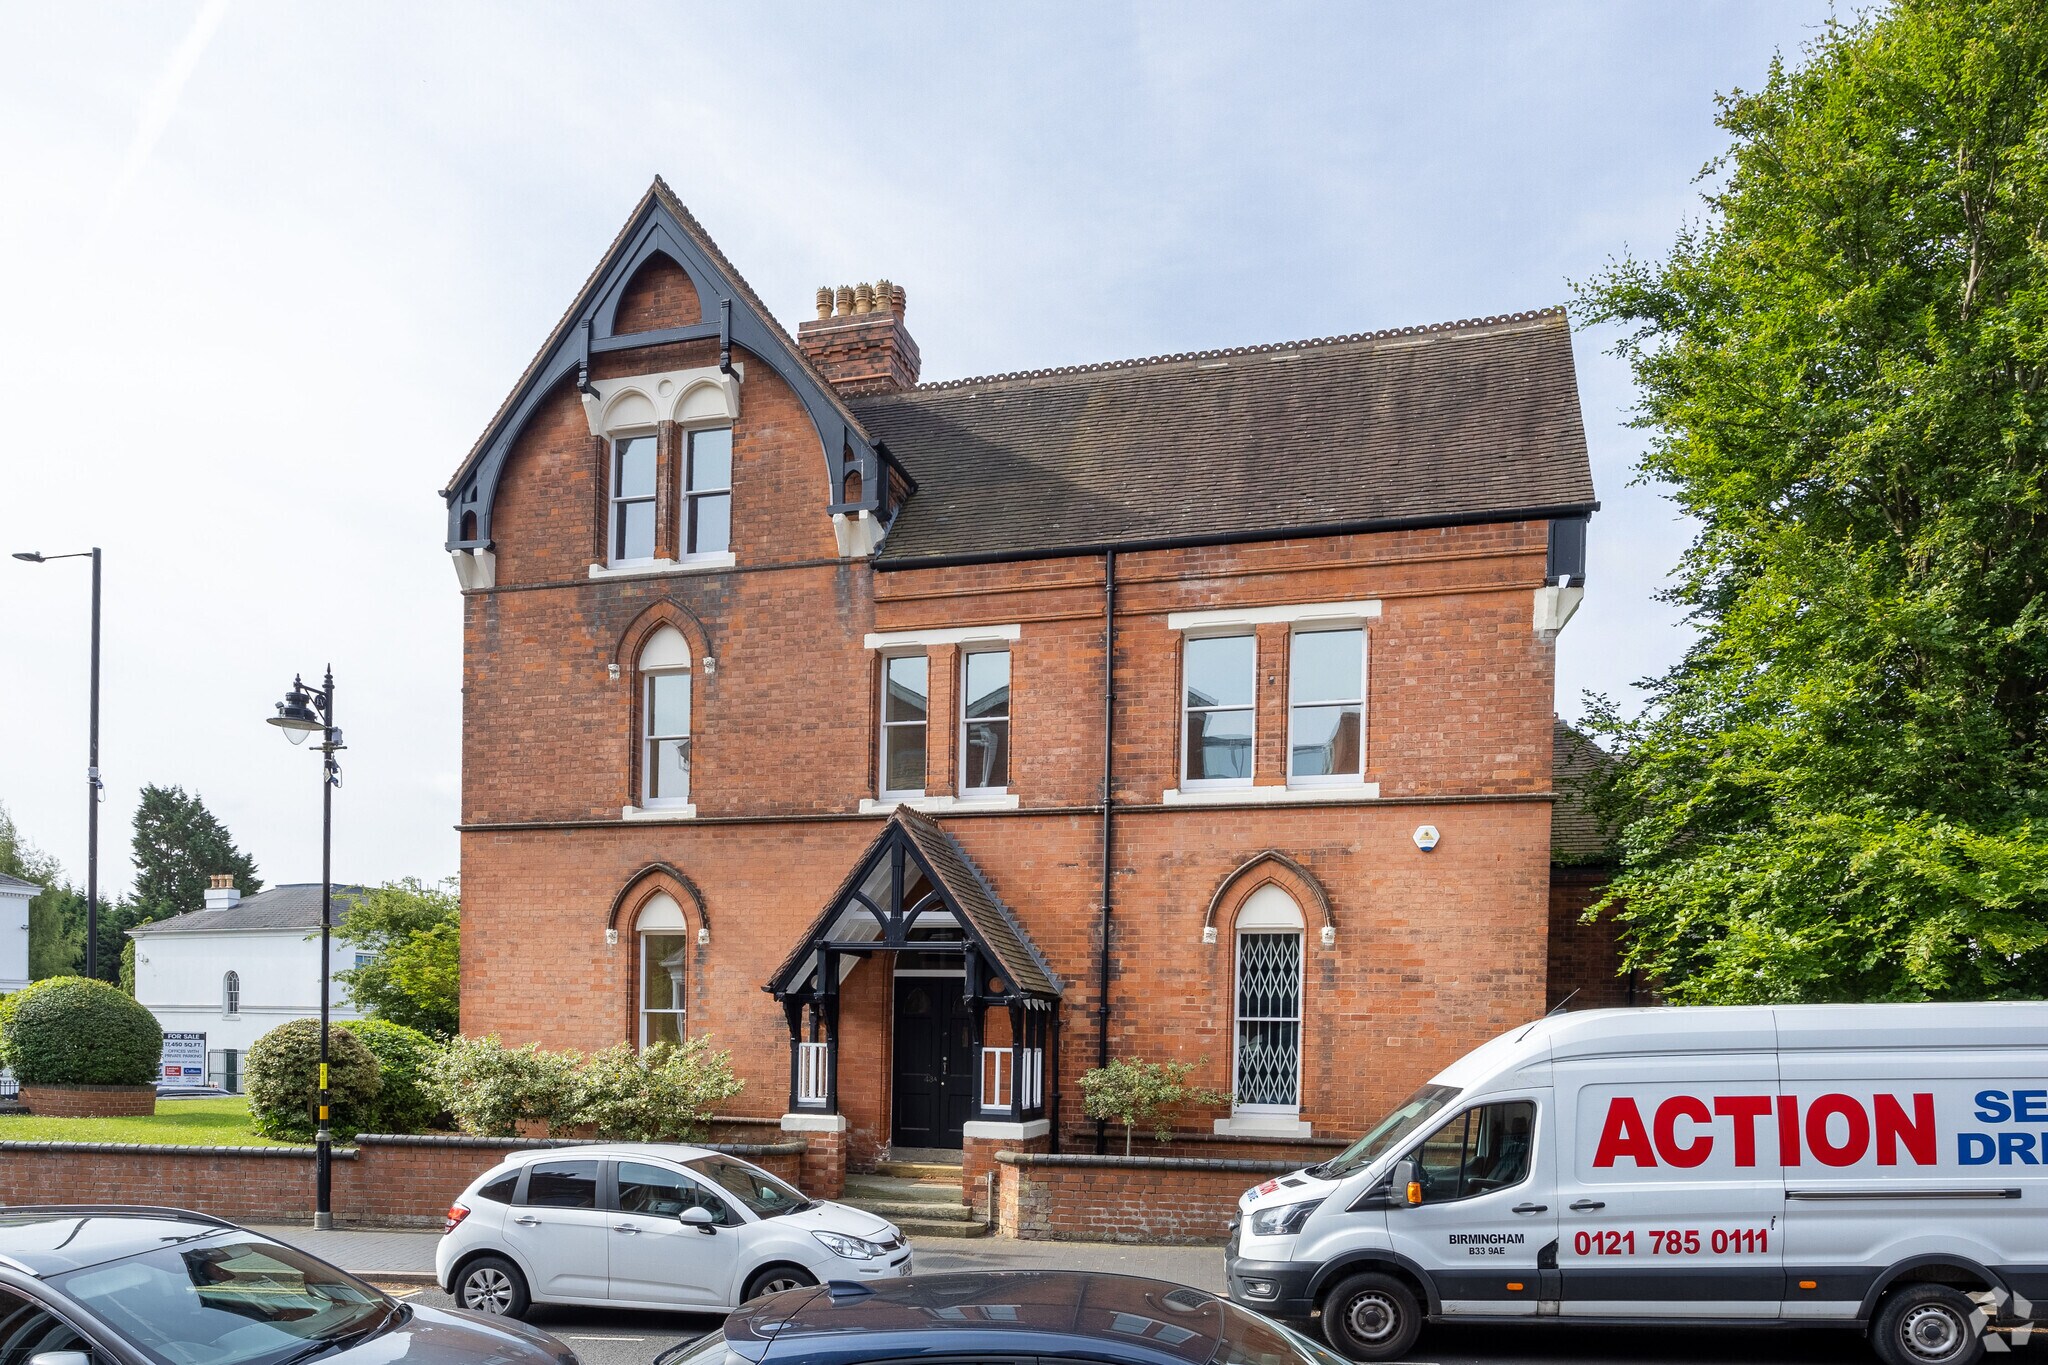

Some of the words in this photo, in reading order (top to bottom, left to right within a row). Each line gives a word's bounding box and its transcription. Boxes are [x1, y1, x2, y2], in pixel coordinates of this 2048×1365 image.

[1974, 1090, 2048, 1123] SE
[1593, 1093, 1937, 1168] ACTION
[1449, 1234, 1524, 1244] BIRMINGHAM
[1469, 1247, 1485, 1255] B33
[1488, 1247, 1505, 1255] 9AE
[1574, 1231, 1635, 1255] 0121
[1648, 1230, 1700, 1255] 785
[1711, 1229, 1767, 1254] 0111
